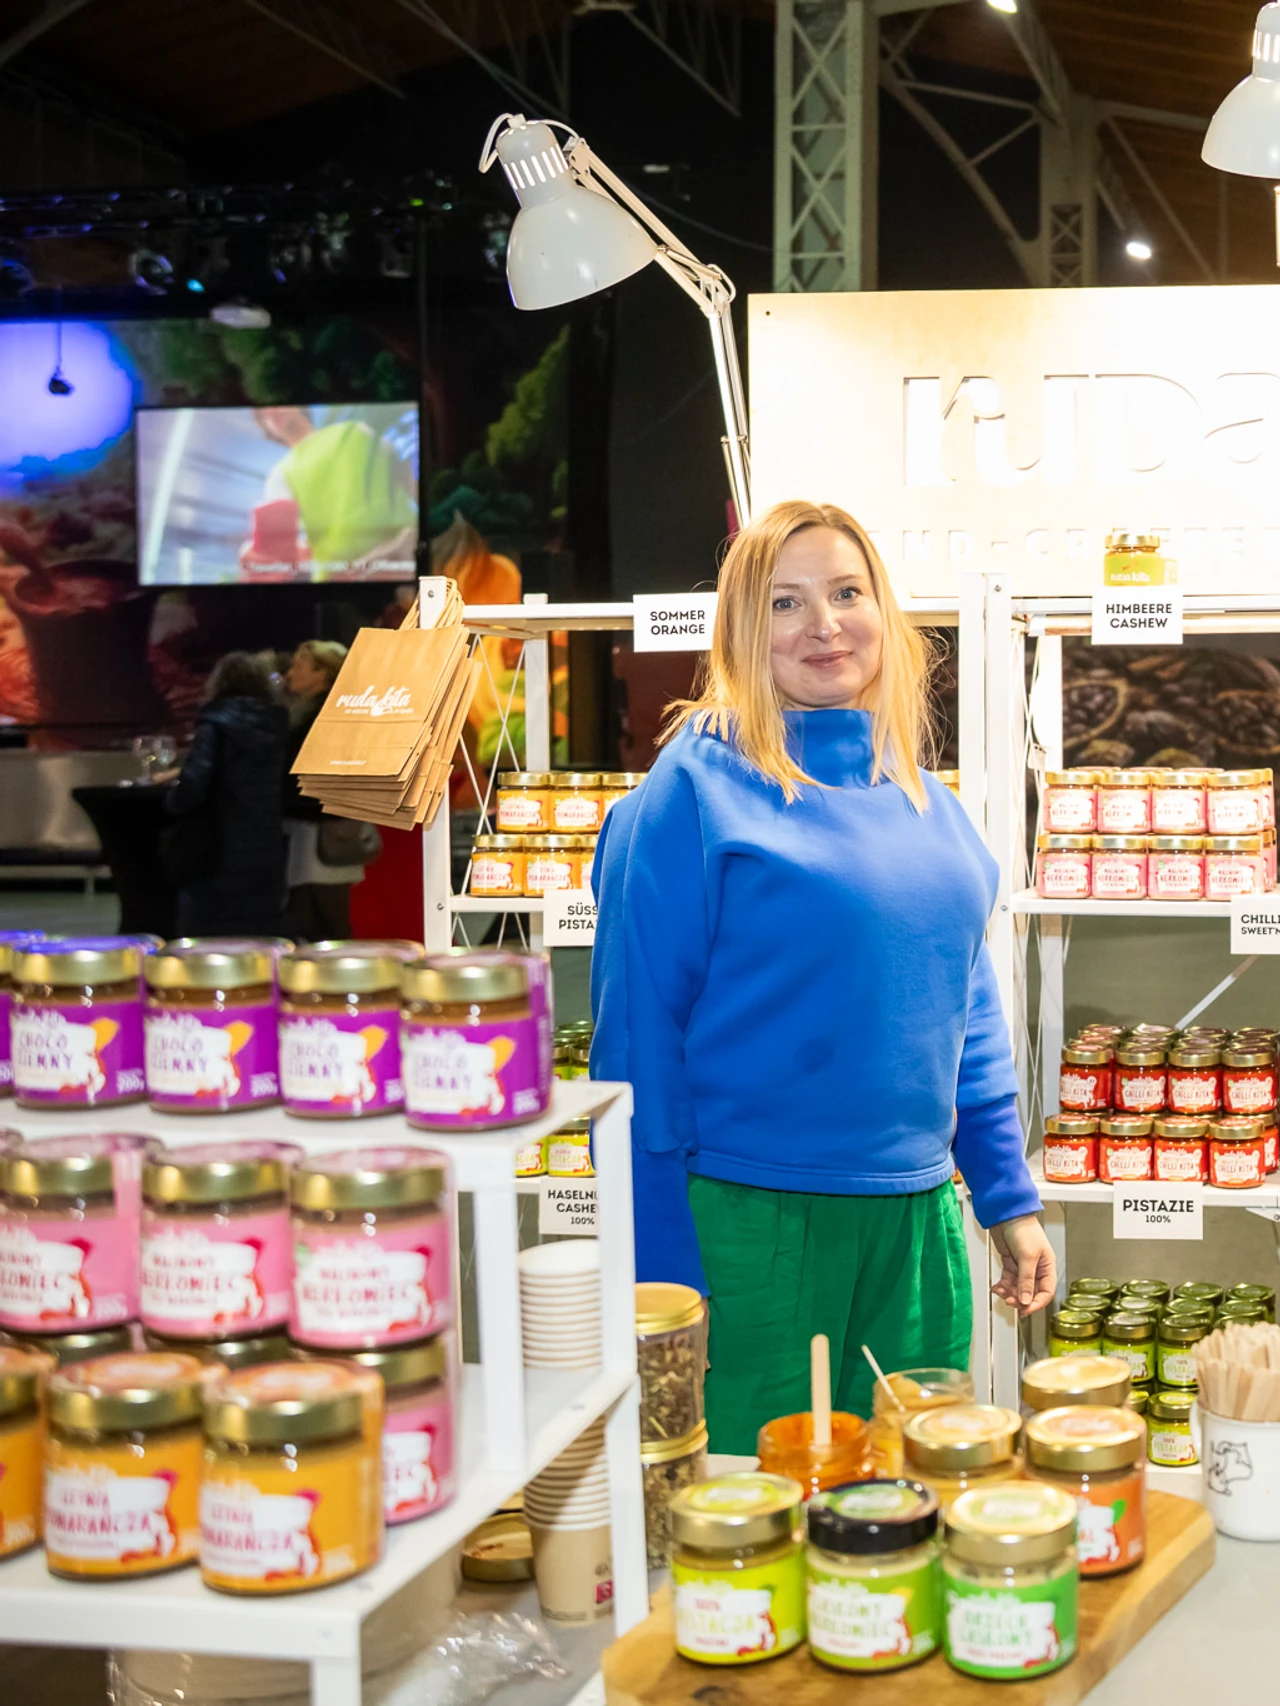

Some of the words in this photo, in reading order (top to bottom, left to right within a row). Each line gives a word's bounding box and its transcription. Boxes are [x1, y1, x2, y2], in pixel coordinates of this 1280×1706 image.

[1106, 603, 1173, 614] HIMBEERE
[650, 609, 705, 621] SOMMER
[650, 623, 705, 635] ORANGE
[1110, 617, 1168, 629] CASHEW
[567, 902, 598, 916] SÜSS
[559, 919, 596, 930] PISTA
[556, 1202, 598, 1214] CASHE
[1123, 1199, 1194, 1212] PISTAZIE
[570, 1216, 595, 1225] 100%
[1145, 1215, 1171, 1223] 100%
